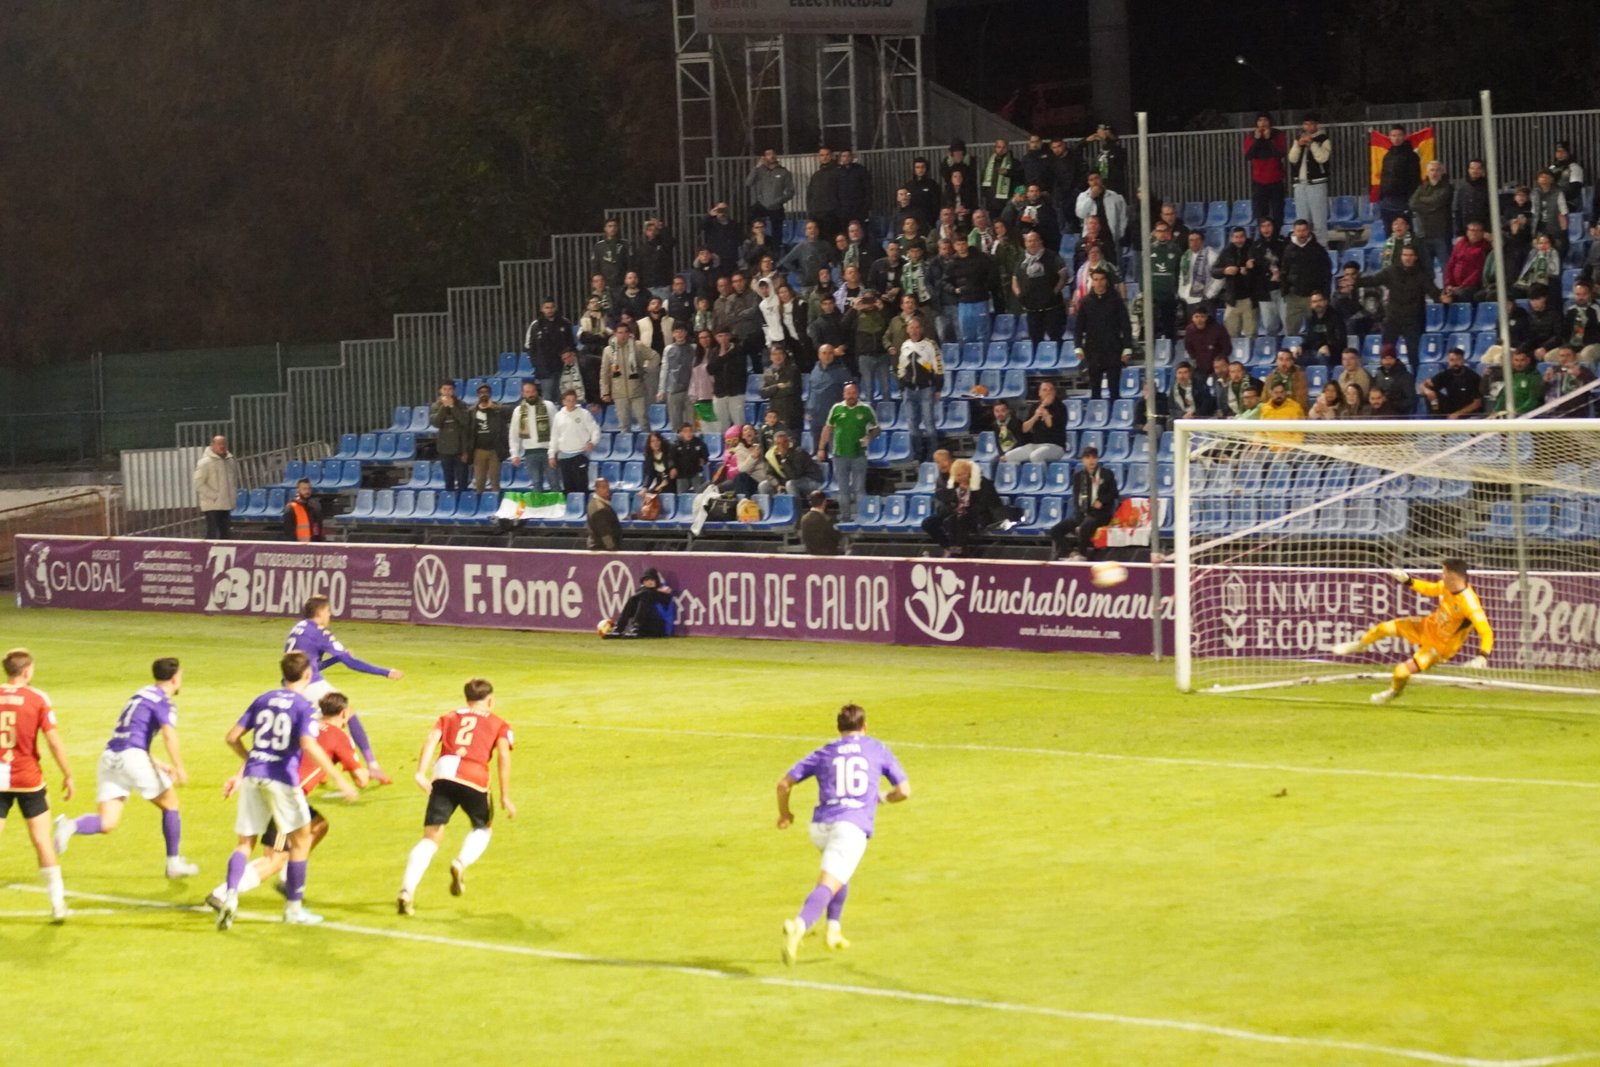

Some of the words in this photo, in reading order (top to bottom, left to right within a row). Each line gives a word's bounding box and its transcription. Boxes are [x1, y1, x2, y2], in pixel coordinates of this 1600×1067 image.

[788, 0, 894, 8] ELECTRICIDAD
[50, 561, 126, 592] GLOBAL
[251, 569, 347, 617] BLANCO
[464, 564, 583, 618] F.Tomé
[708, 571, 756, 626] RED
[764, 573, 797, 628] DE
[805, 574, 890, 631] CALOR
[254, 709, 292, 751] 29
[455, 716, 478, 745] 2
[832, 756, 869, 797] 16
